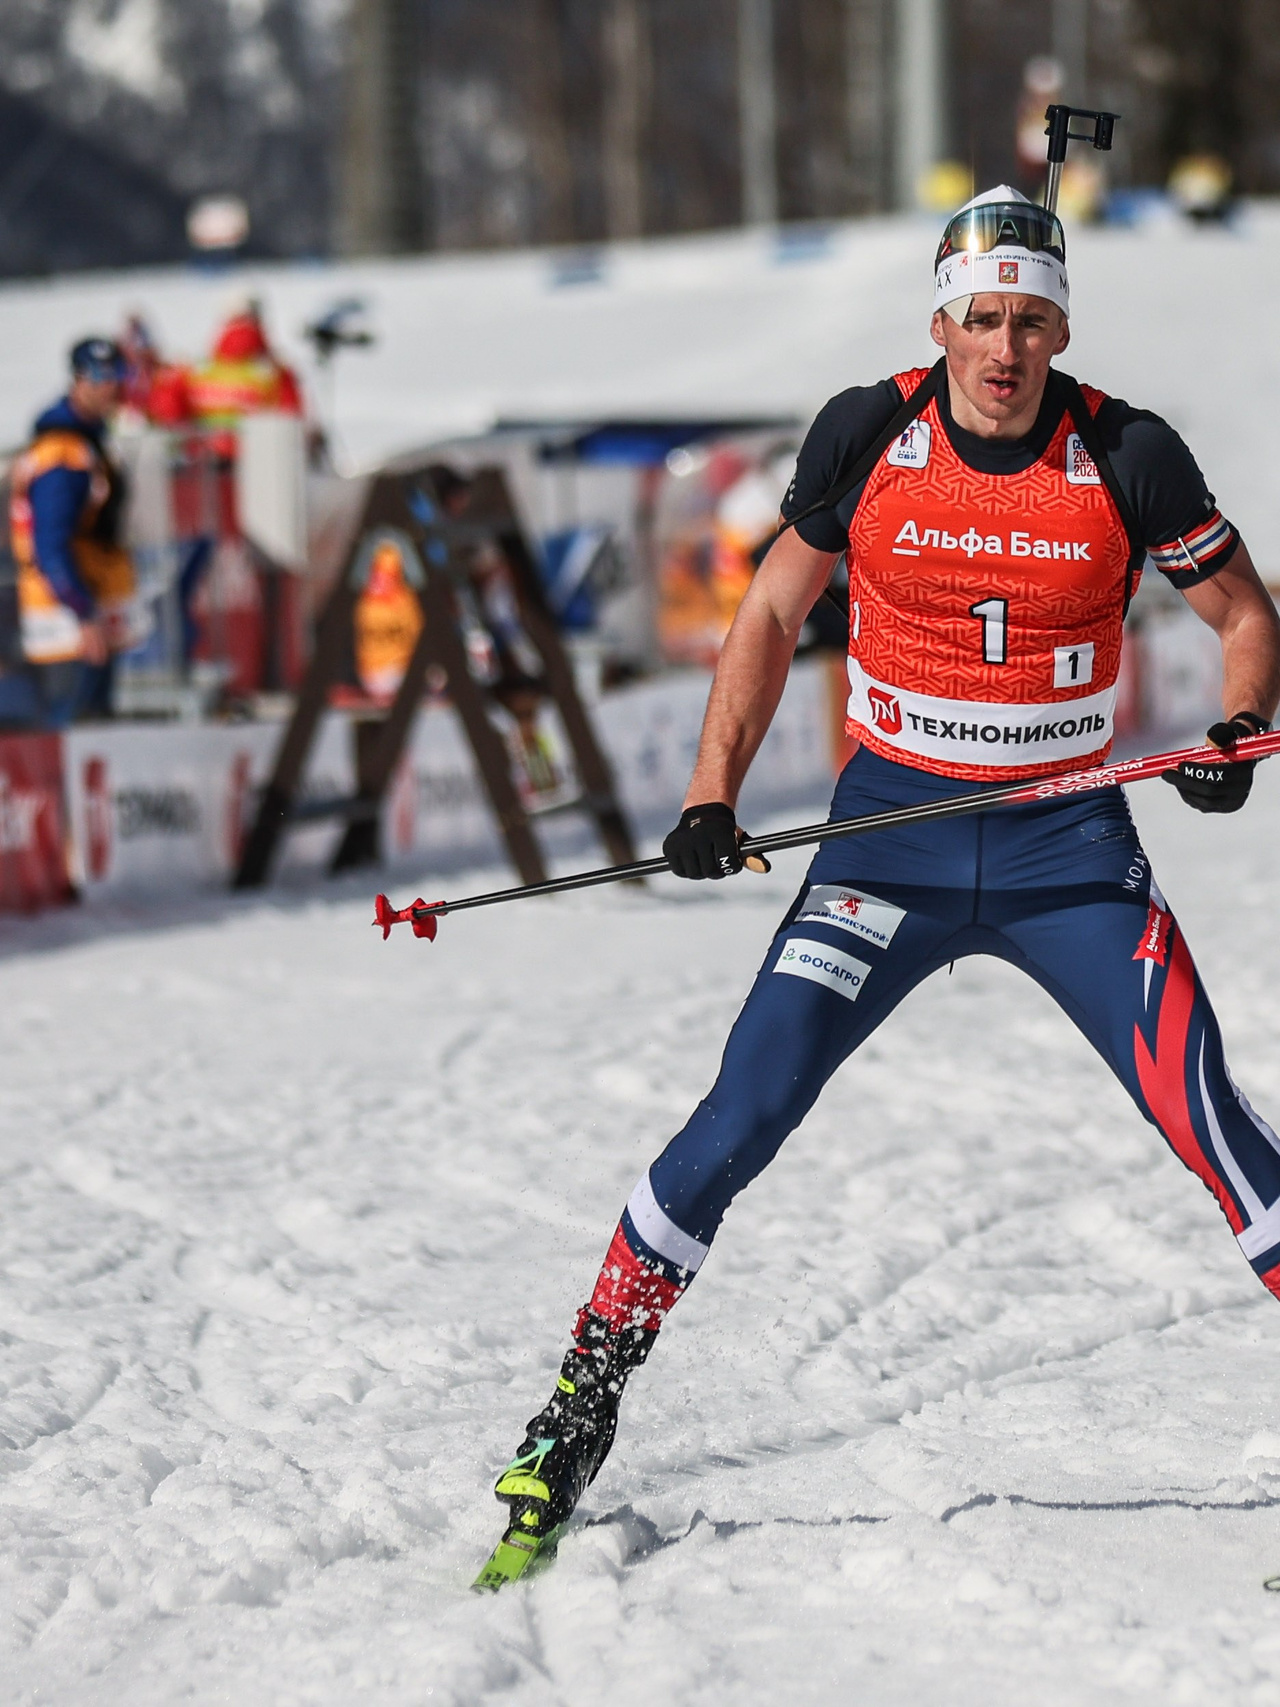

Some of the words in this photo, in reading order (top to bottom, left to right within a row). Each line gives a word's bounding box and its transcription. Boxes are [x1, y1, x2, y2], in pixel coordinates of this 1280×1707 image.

[897, 453, 917, 461] СБР
[892, 519, 1003, 558] Альфа
[1010, 531, 1093, 561] Банк
[968, 596, 1009, 665] 1
[1067, 651, 1079, 680] 1
[906, 711, 1106, 745] ТЕХНОНИКОЛЬ
[1036, 777, 1117, 800] MOAX
[1184, 765, 1224, 782] MOAX
[798, 953, 861, 987] ФОСАГРО
